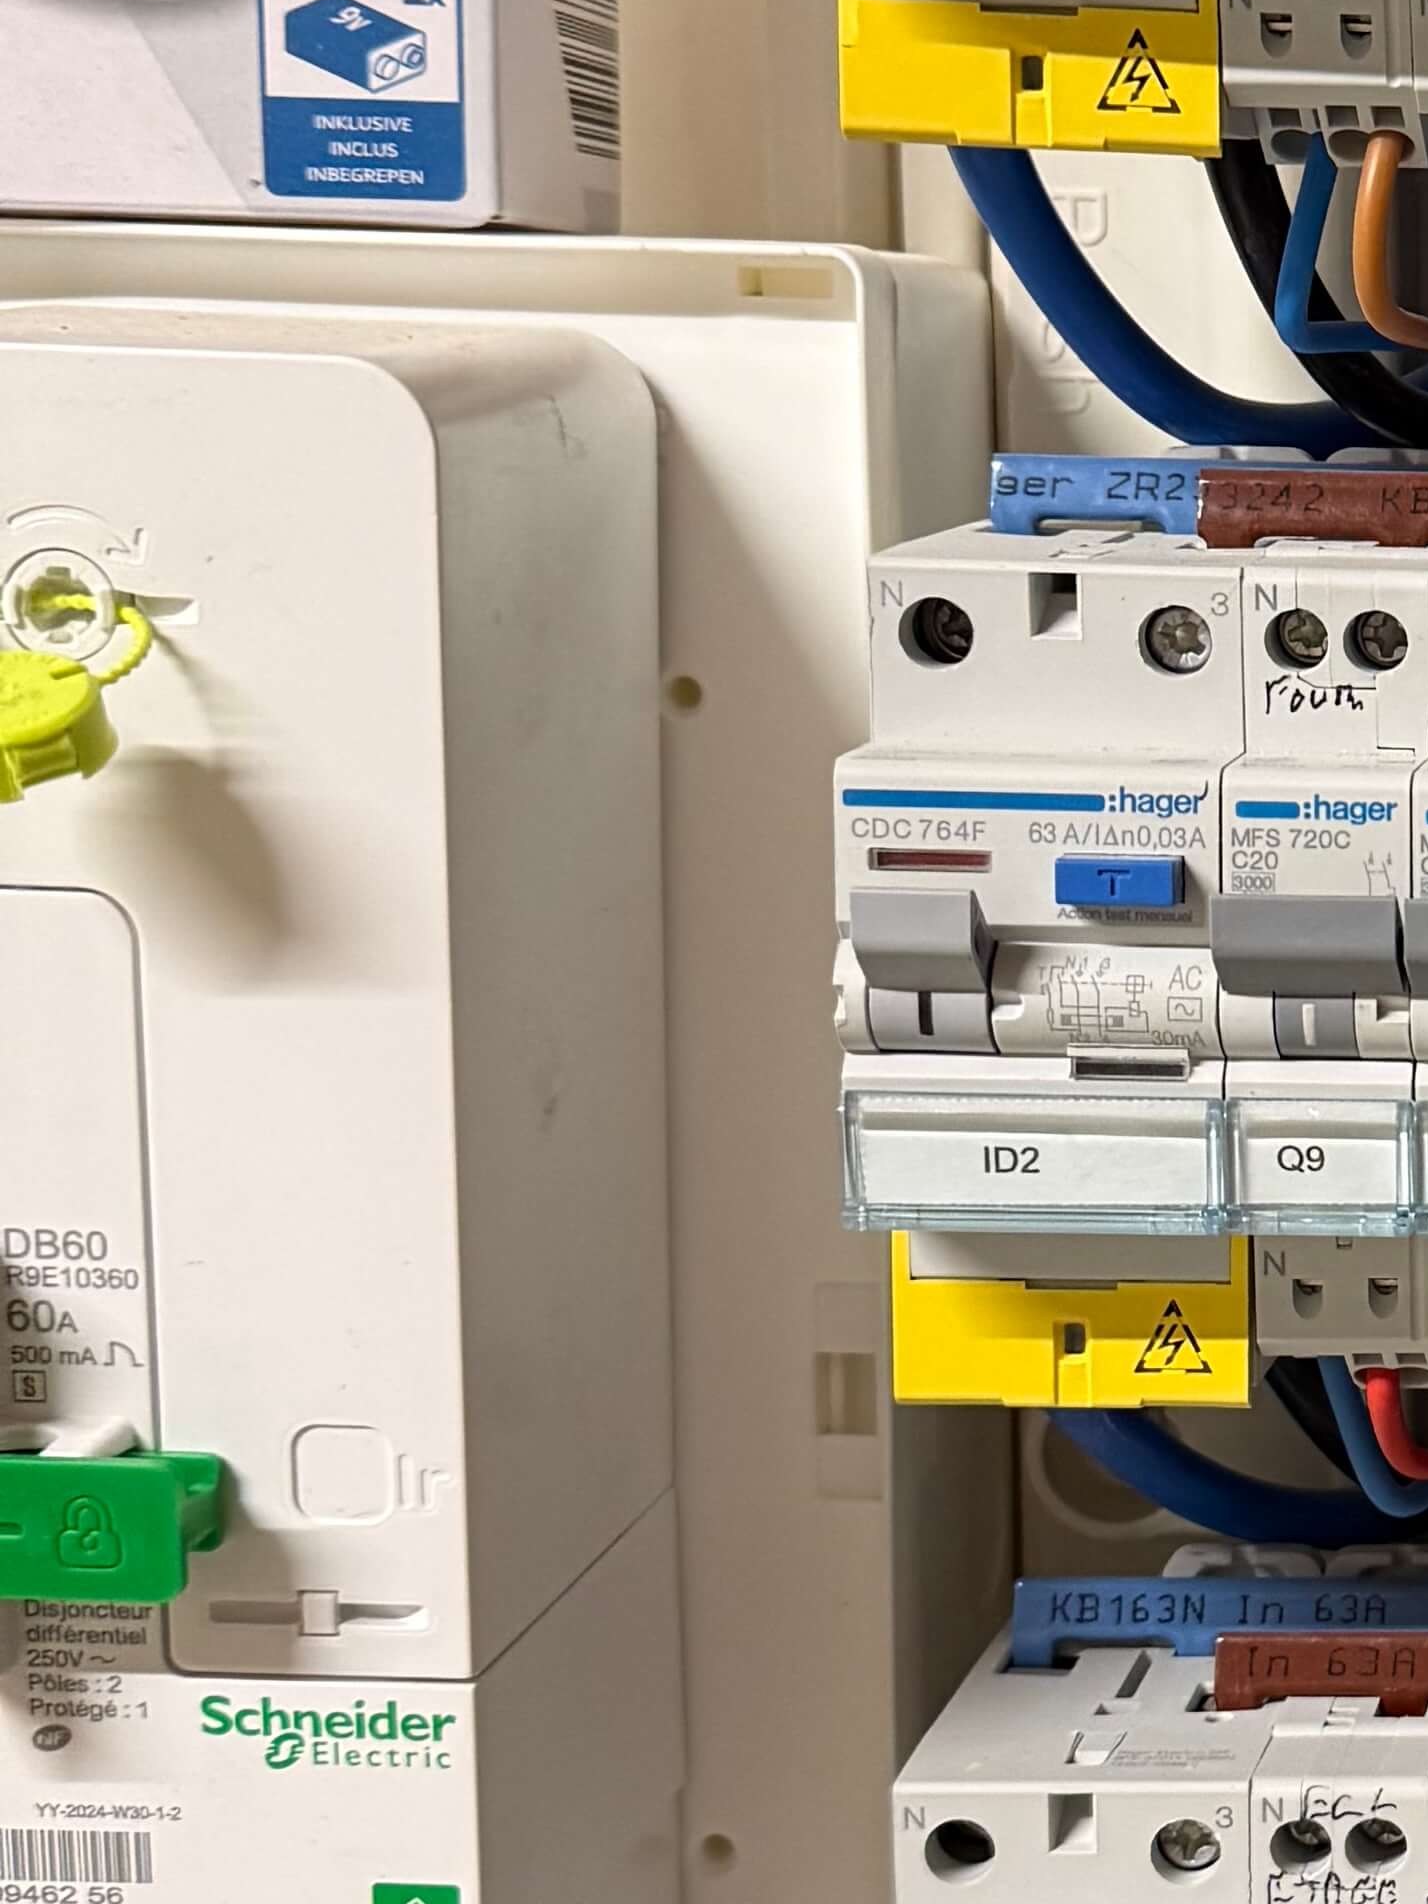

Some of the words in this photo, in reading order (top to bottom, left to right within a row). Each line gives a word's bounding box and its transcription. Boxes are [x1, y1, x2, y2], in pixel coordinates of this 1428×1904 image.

[314, 115, 412, 132] INKLUSIVE
[329, 142, 398, 158] INCLUS
[306, 167, 424, 185] INBEGREPEN
[851, 819, 912, 840] CDC
[919, 819, 986, 842] 764F
[1028, 822, 1057, 844] 63
[984, 1146, 1041, 1174] ID2
[1277, 1146, 1325, 1174] Q9
[4, 1228, 108, 1260] DB60
[6, 1267, 139, 1290] R9E10360
[7, 1299, 78, 1333] 60A
[10, 1346, 52, 1366] 500
[59, 1347, 97, 1365] mA
[23, 1599, 152, 1621] Disjoncteur
[1049, 1594, 1207, 1624] KB163N
[1236, 1596, 1285, 1624] In
[1314, 1596, 1387, 1623] 63A
[26, 1625, 147, 1645] différentiel
[28, 1674, 89, 1693] Pôles
[108, 1676, 123, 1693] 2
[29, 1700, 115, 1721] Protégé
[140, 1703, 148, 1719] 1
[201, 1696, 457, 1742] Schneider
[311, 1742, 452, 1768] Electric
[36, 1803, 182, 1821] YY-2024-W30-1-2
[88, 1886, 123, 1904] 56
